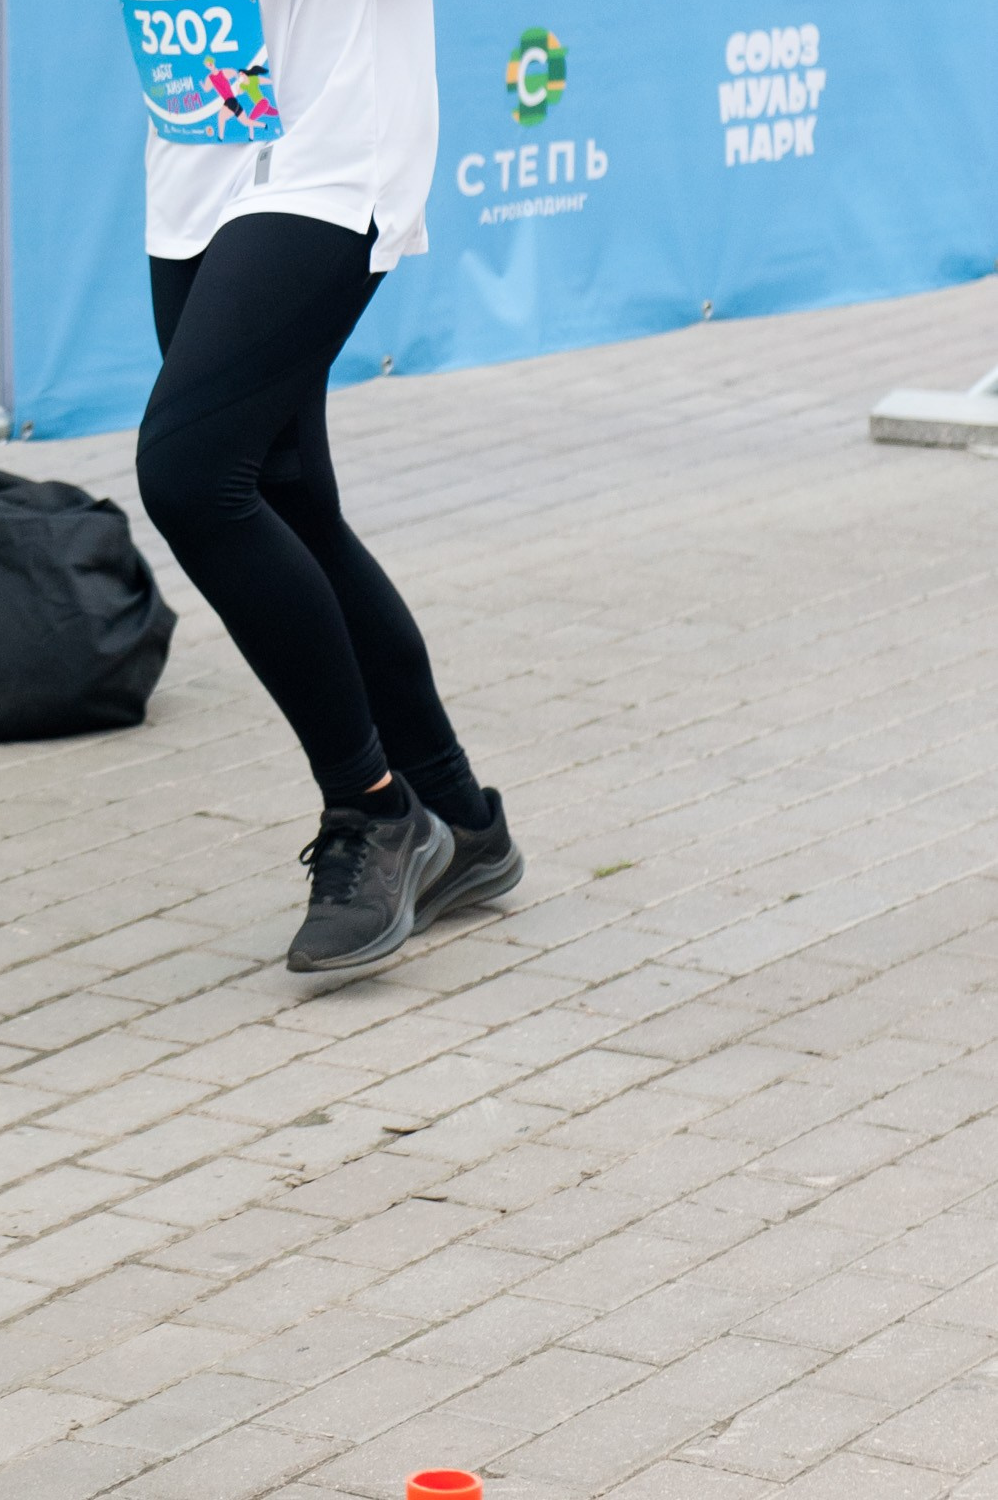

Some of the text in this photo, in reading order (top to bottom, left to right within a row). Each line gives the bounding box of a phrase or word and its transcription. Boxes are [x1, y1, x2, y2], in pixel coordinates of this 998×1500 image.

[134, 6, 239, 56] 3202
[725, 23, 821, 76] СОЮЗ
[718, 68, 827, 124] МУЛЬТ
[456, 138, 609, 197] СТЕПЬ
[724, 116, 817, 168] ПАРК
[479, 192, 588, 227] АГРОХОЛДИНГ
